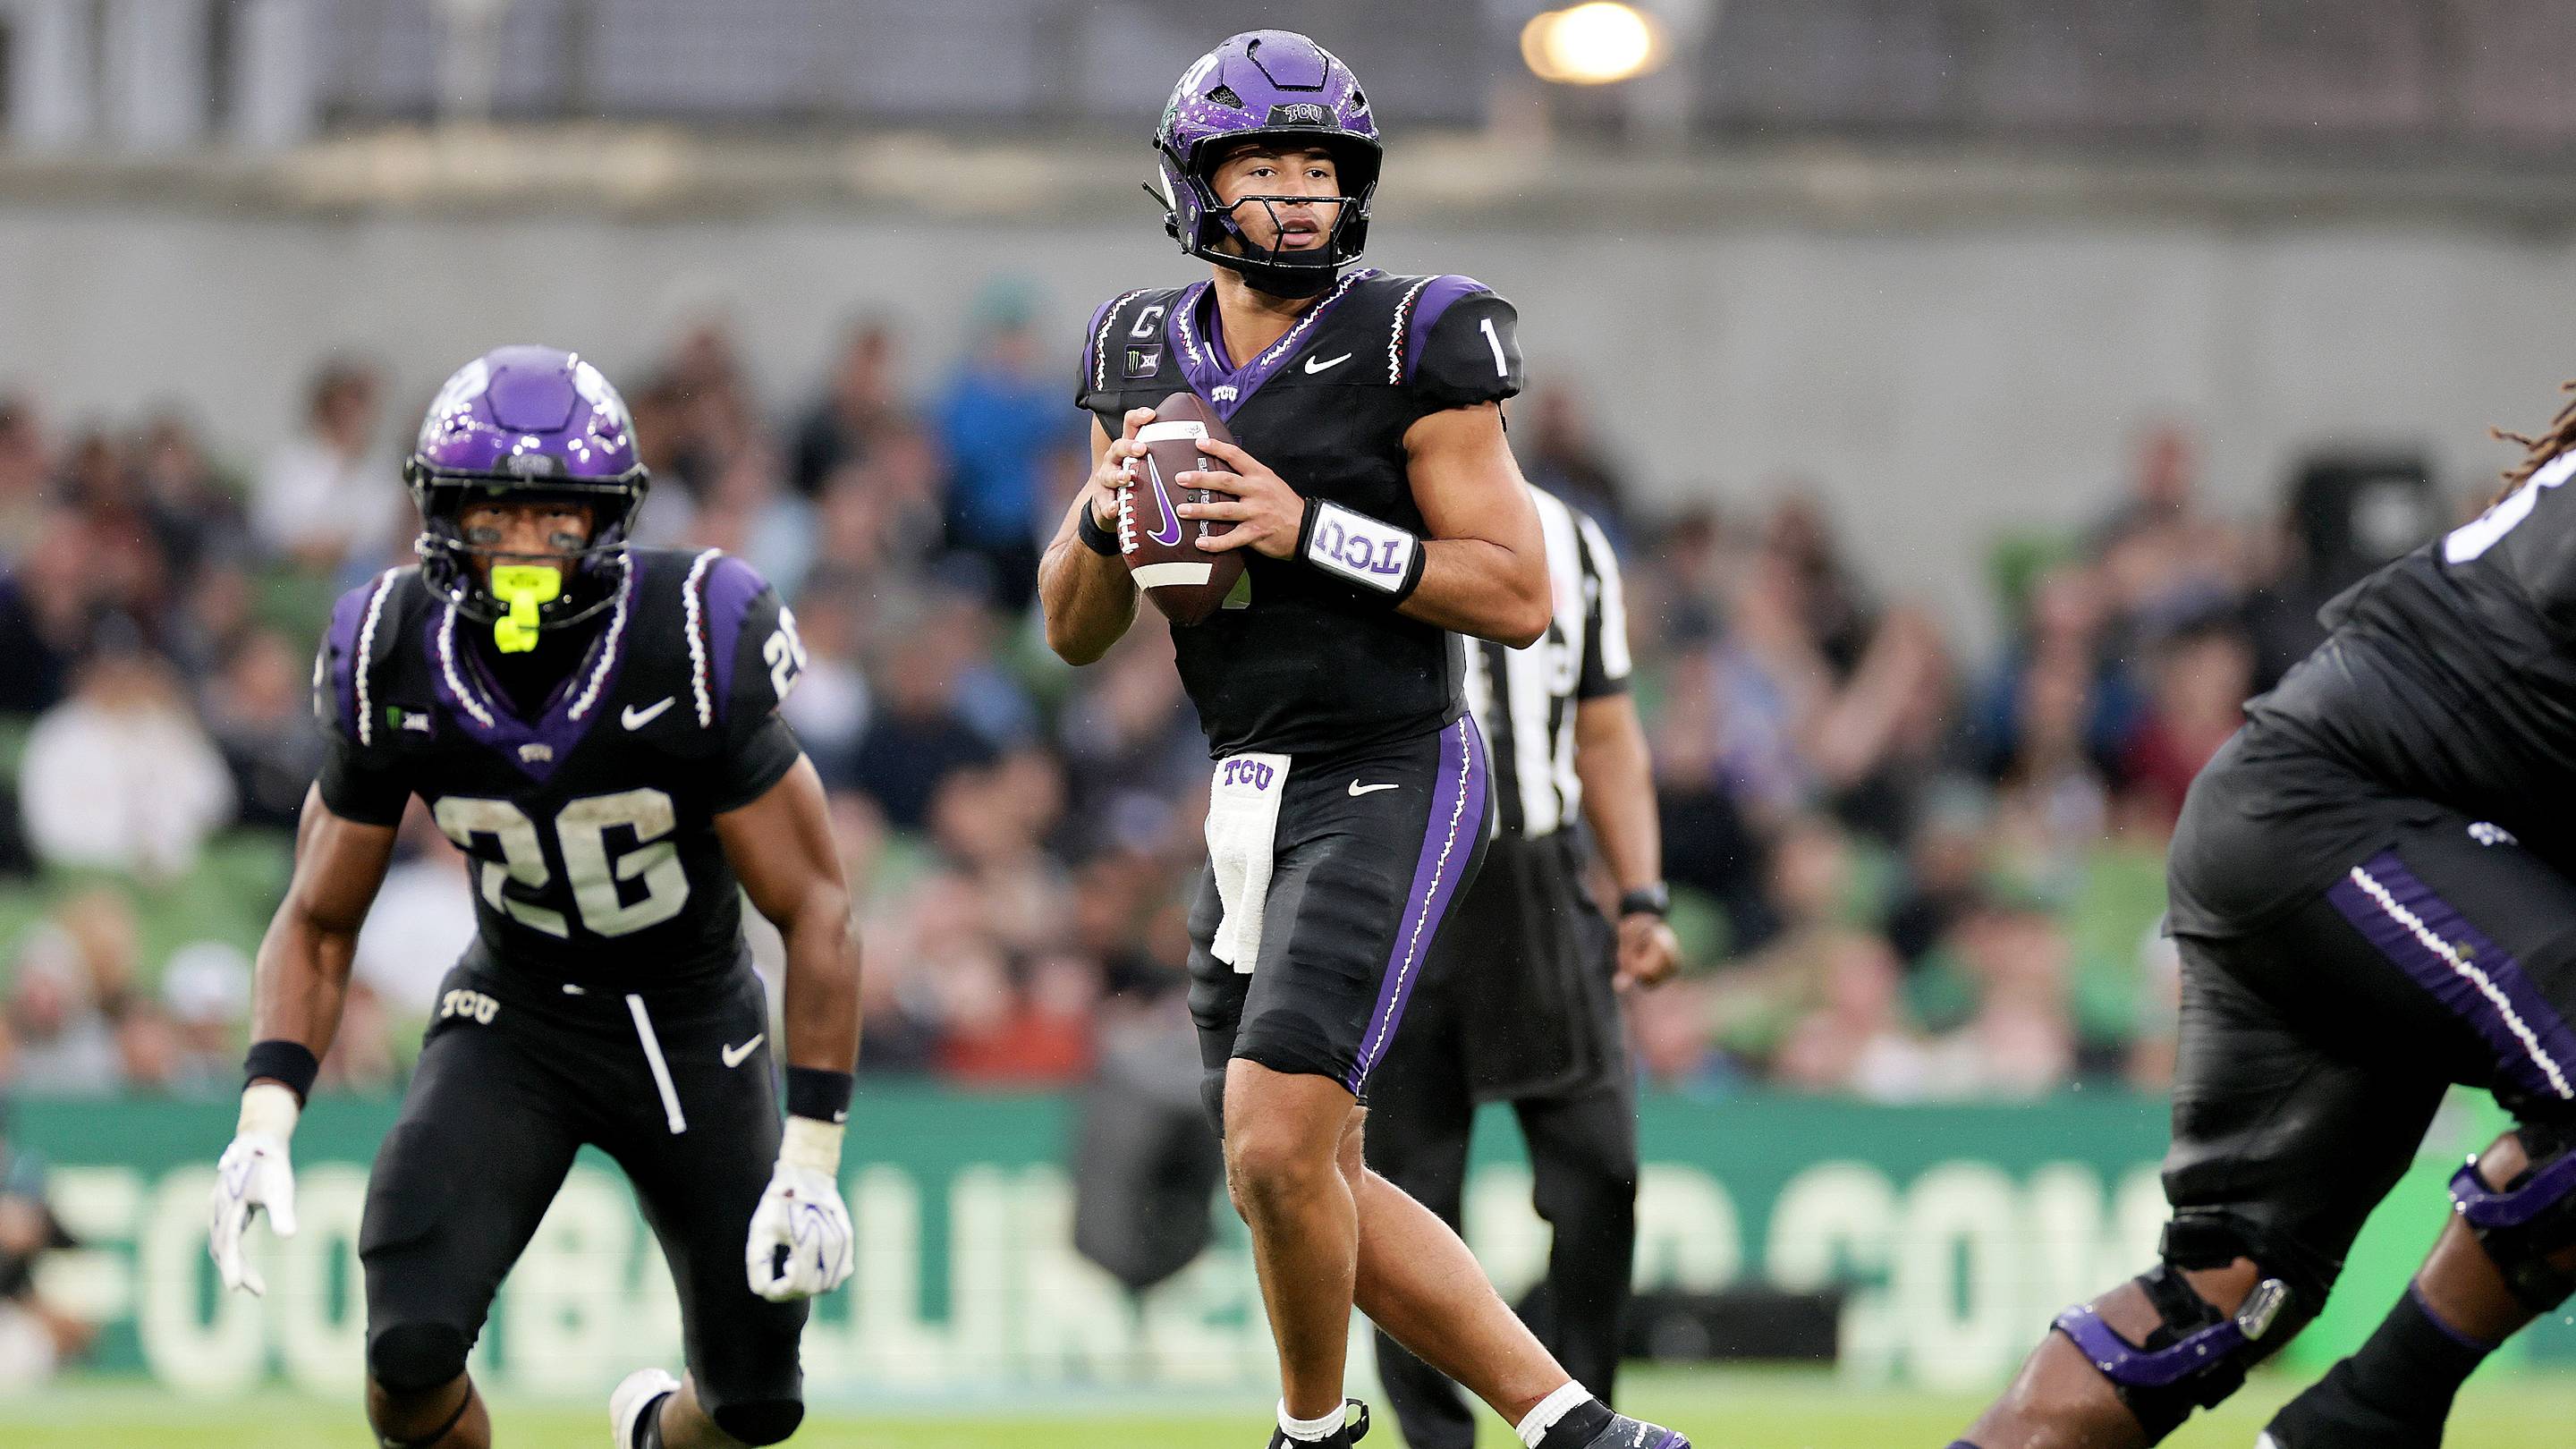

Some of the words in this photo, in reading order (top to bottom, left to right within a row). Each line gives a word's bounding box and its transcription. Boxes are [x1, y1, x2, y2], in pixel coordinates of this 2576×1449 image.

[1284, 103, 1322, 123] TCU
[1130, 305, 1165, 339] C
[1480, 318, 1508, 377] 1
[1211, 385, 1239, 402] TCU
[1314, 520, 1402, 575] TCU
[1224, 759, 1274, 791] TCU
[433, 786, 691, 938] 26
[441, 988, 500, 1025] TCU
